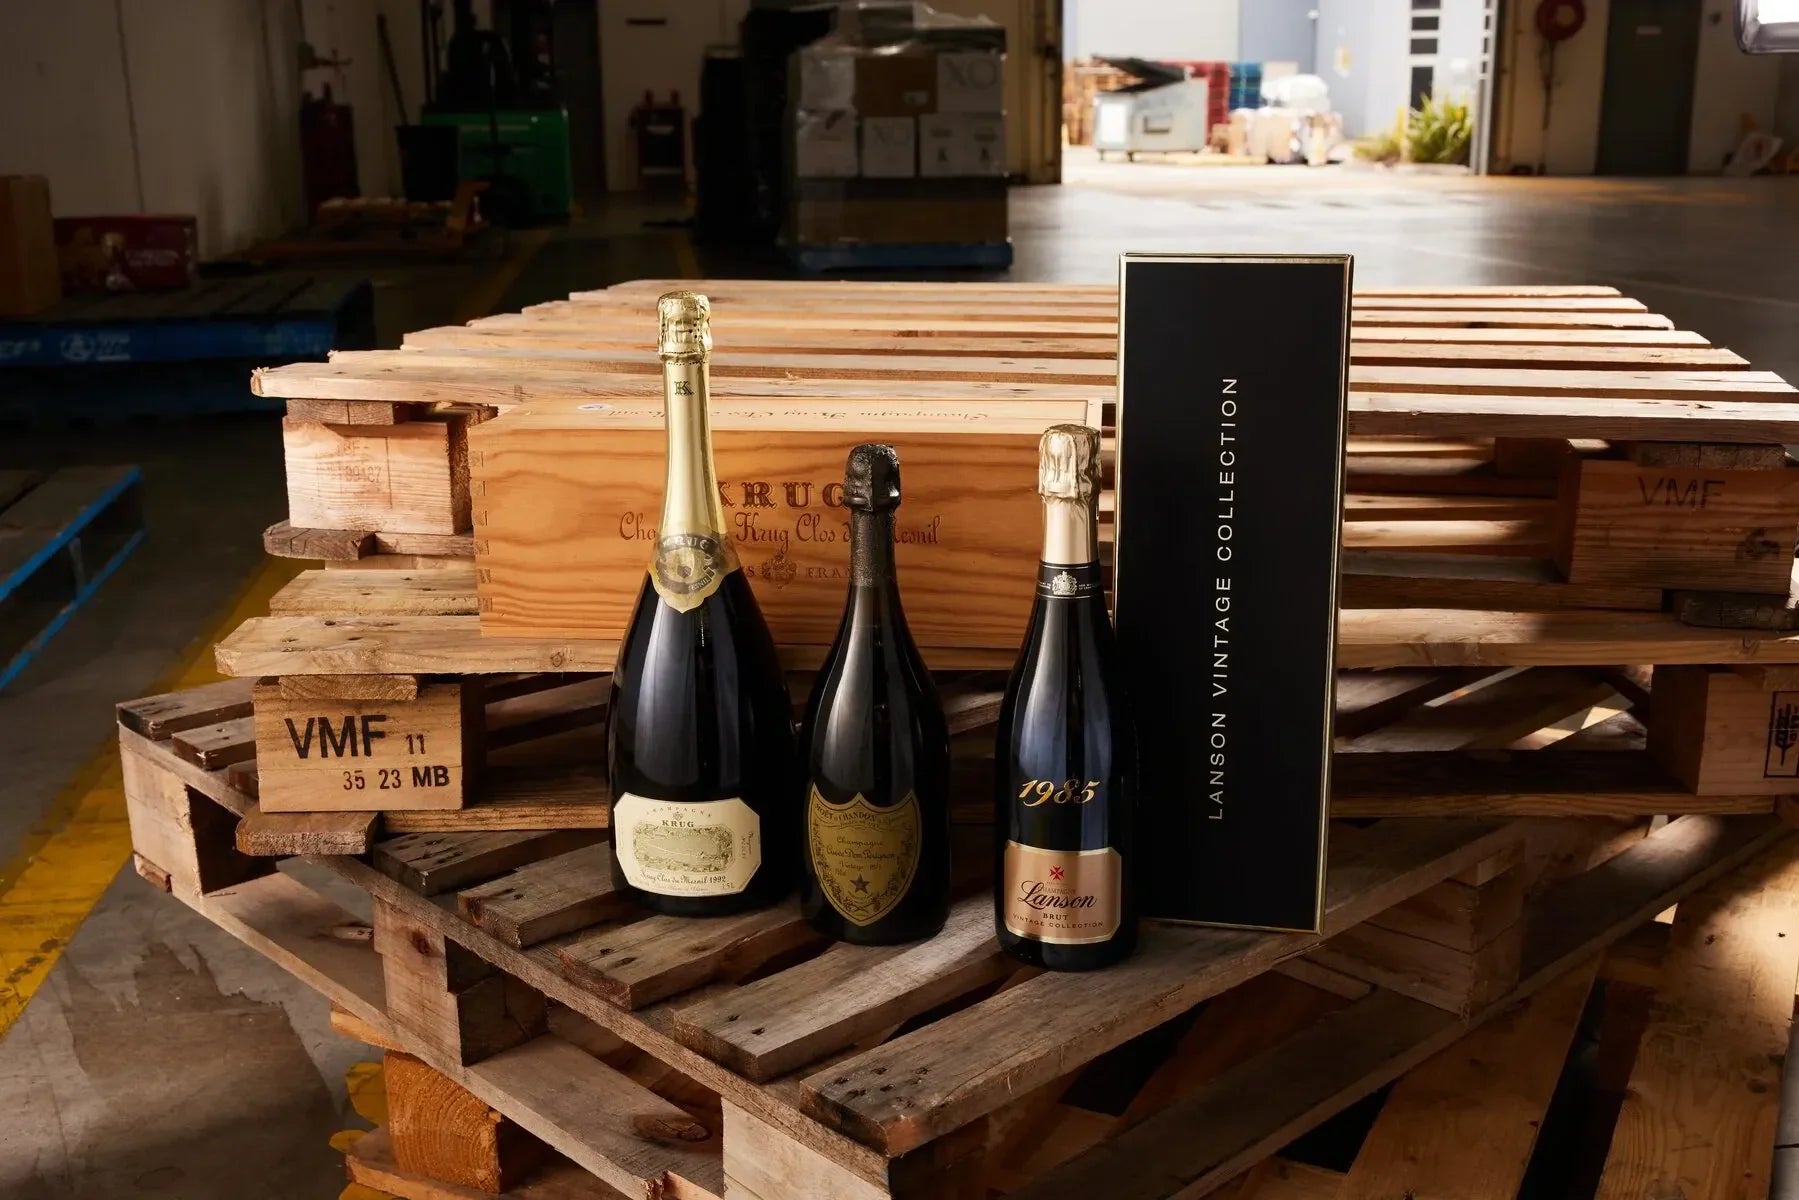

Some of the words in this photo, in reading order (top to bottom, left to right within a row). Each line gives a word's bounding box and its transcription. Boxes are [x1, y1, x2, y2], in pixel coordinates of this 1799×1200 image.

[944, 58, 999, 89] XO
[674, 380, 694, 396] K
[1216, 378, 1238, 561] COLLECTION
[1637, 475, 1726, 509] VMF
[735, 512, 789, 553] Krug
[796, 513, 836, 544] Clos
[1212, 578, 1232, 697] VINTAGE
[284, 714, 387, 759] VMF
[405, 733, 426, 755] 11
[343, 769, 365, 791] 35
[378, 769, 402, 790] 23
[412, 765, 450, 788] MB
[1208, 712, 1227, 820] LANSON
[1018, 779, 1101, 807] 1985
[661, 819, 694, 828] KRUG
[836, 836, 884, 848] Champagne
[656, 873, 671, 882] Clos
[680, 874, 708, 885] Mesnil
[709, 875, 727, 885] 1992
[1016, 879, 1097, 910] Lanson
[1012, 912, 1045, 927] VINTAGE
[1048, 920, 1104, 929] COLLECTION
[1042, 912, 1070, 921] BRUT
